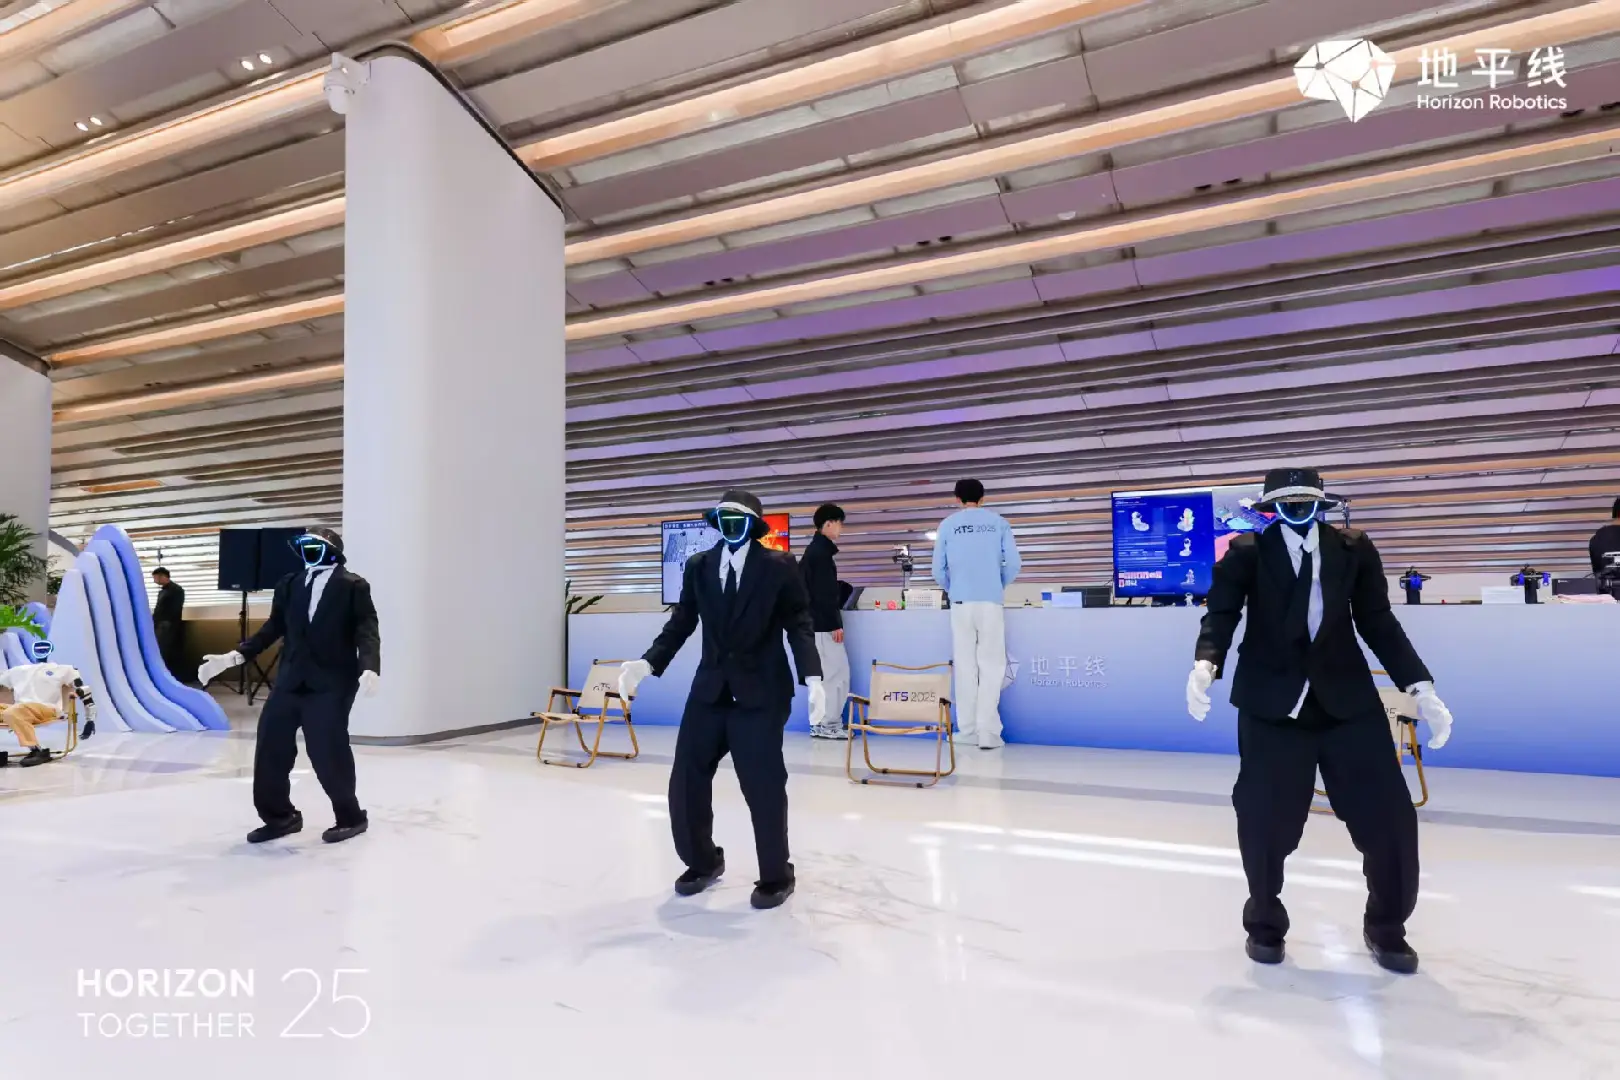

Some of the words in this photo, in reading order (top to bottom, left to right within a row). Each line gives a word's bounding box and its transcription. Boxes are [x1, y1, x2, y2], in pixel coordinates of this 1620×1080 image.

[1030, 655, 1105, 677] 地平线
[910, 691, 937, 702] 2025
